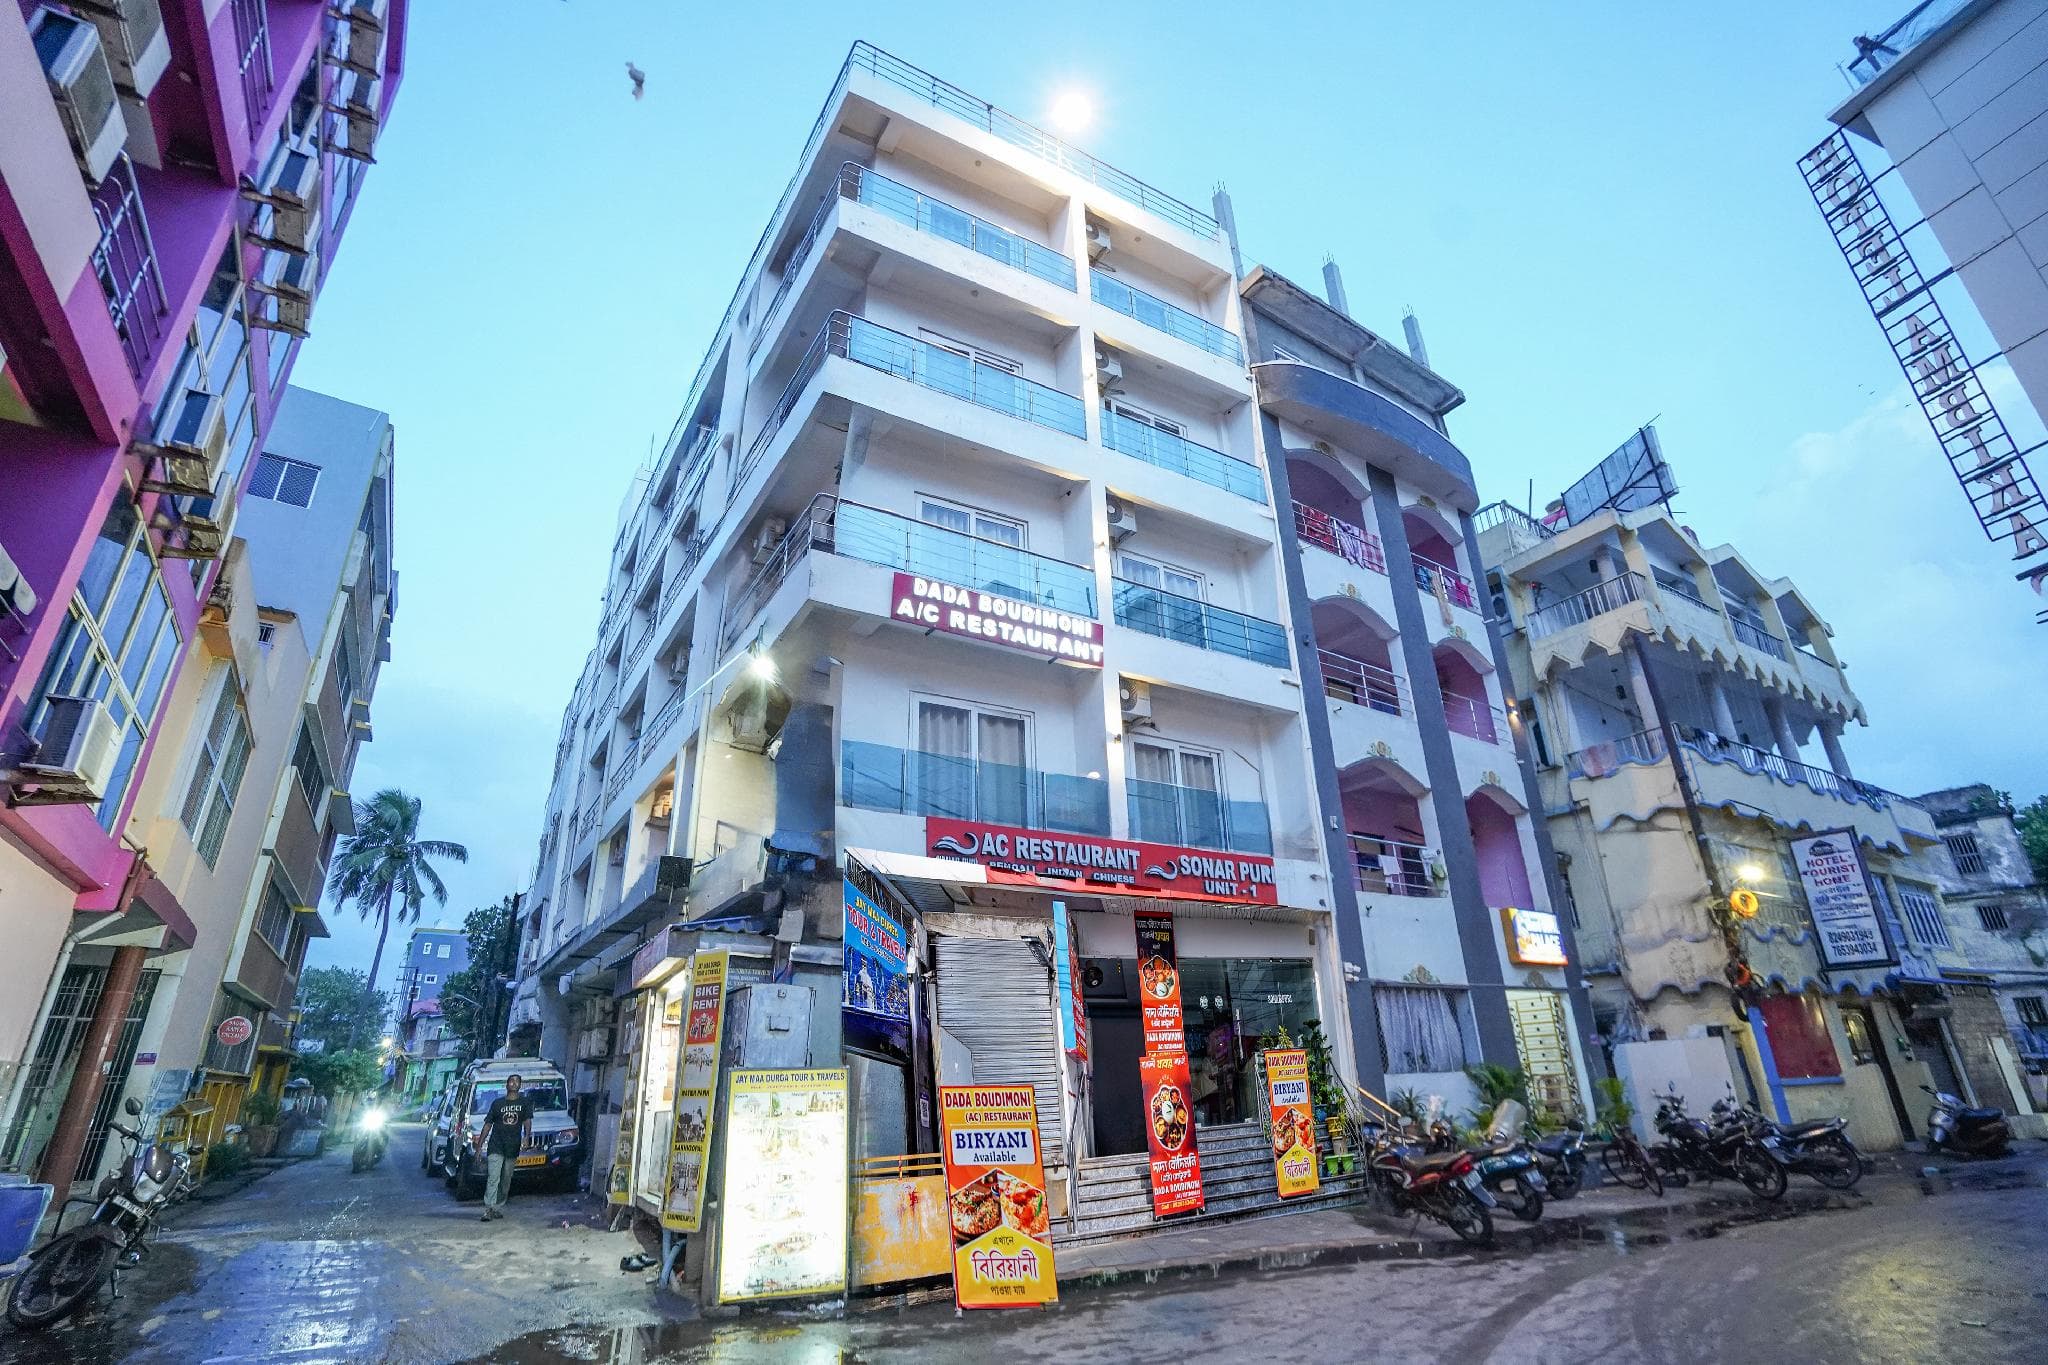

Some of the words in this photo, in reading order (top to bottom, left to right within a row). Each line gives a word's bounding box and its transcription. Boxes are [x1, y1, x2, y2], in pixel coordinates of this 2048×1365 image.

[913, 577, 971, 609] DADA
[896, 598, 940, 623] A/C
[949, 609, 1103, 663] RESTAURANT
[981, 832, 1009, 857] AC
[1015, 836, 1140, 871] RESTAURANT
[1179, 855, 1236, 880] SONAR
[1807, 855, 1848, 868] HOTEL
[1800, 864, 1856, 877] TOURIST
[1093, 872, 1136, 884] CHINESE
[1814, 875, 1851, 887] HOME
[1204, 880, 1238, 895] UNIT
[1248, 885, 1257, 897] 1
[846, 903, 869, 936] TOUR
[877, 925, 906, 963] TRAVELS
[695, 985, 720, 997] BIKE
[692, 998, 720, 1010] RENT
[736, 1074, 748, 1083] JAY
[749, 1074, 764, 1083] MAA
[766, 1074, 789, 1082] DURGA
[791, 1073, 809, 1082] TOUR
[816, 1072, 845, 1081] TRAVELS
[944, 1092, 972, 1108] DADA
[975, 1092, 1031, 1107] BOUDIMONI
[965, 1113, 982, 1123] (AC)
[984, 1112, 1032, 1122] RESTAURANT
[955, 1132, 1028, 1149] BIRYANI
[973, 1151, 1016, 1162] Available
[971, 1249, 1038, 1279] বিরিয়ানী
